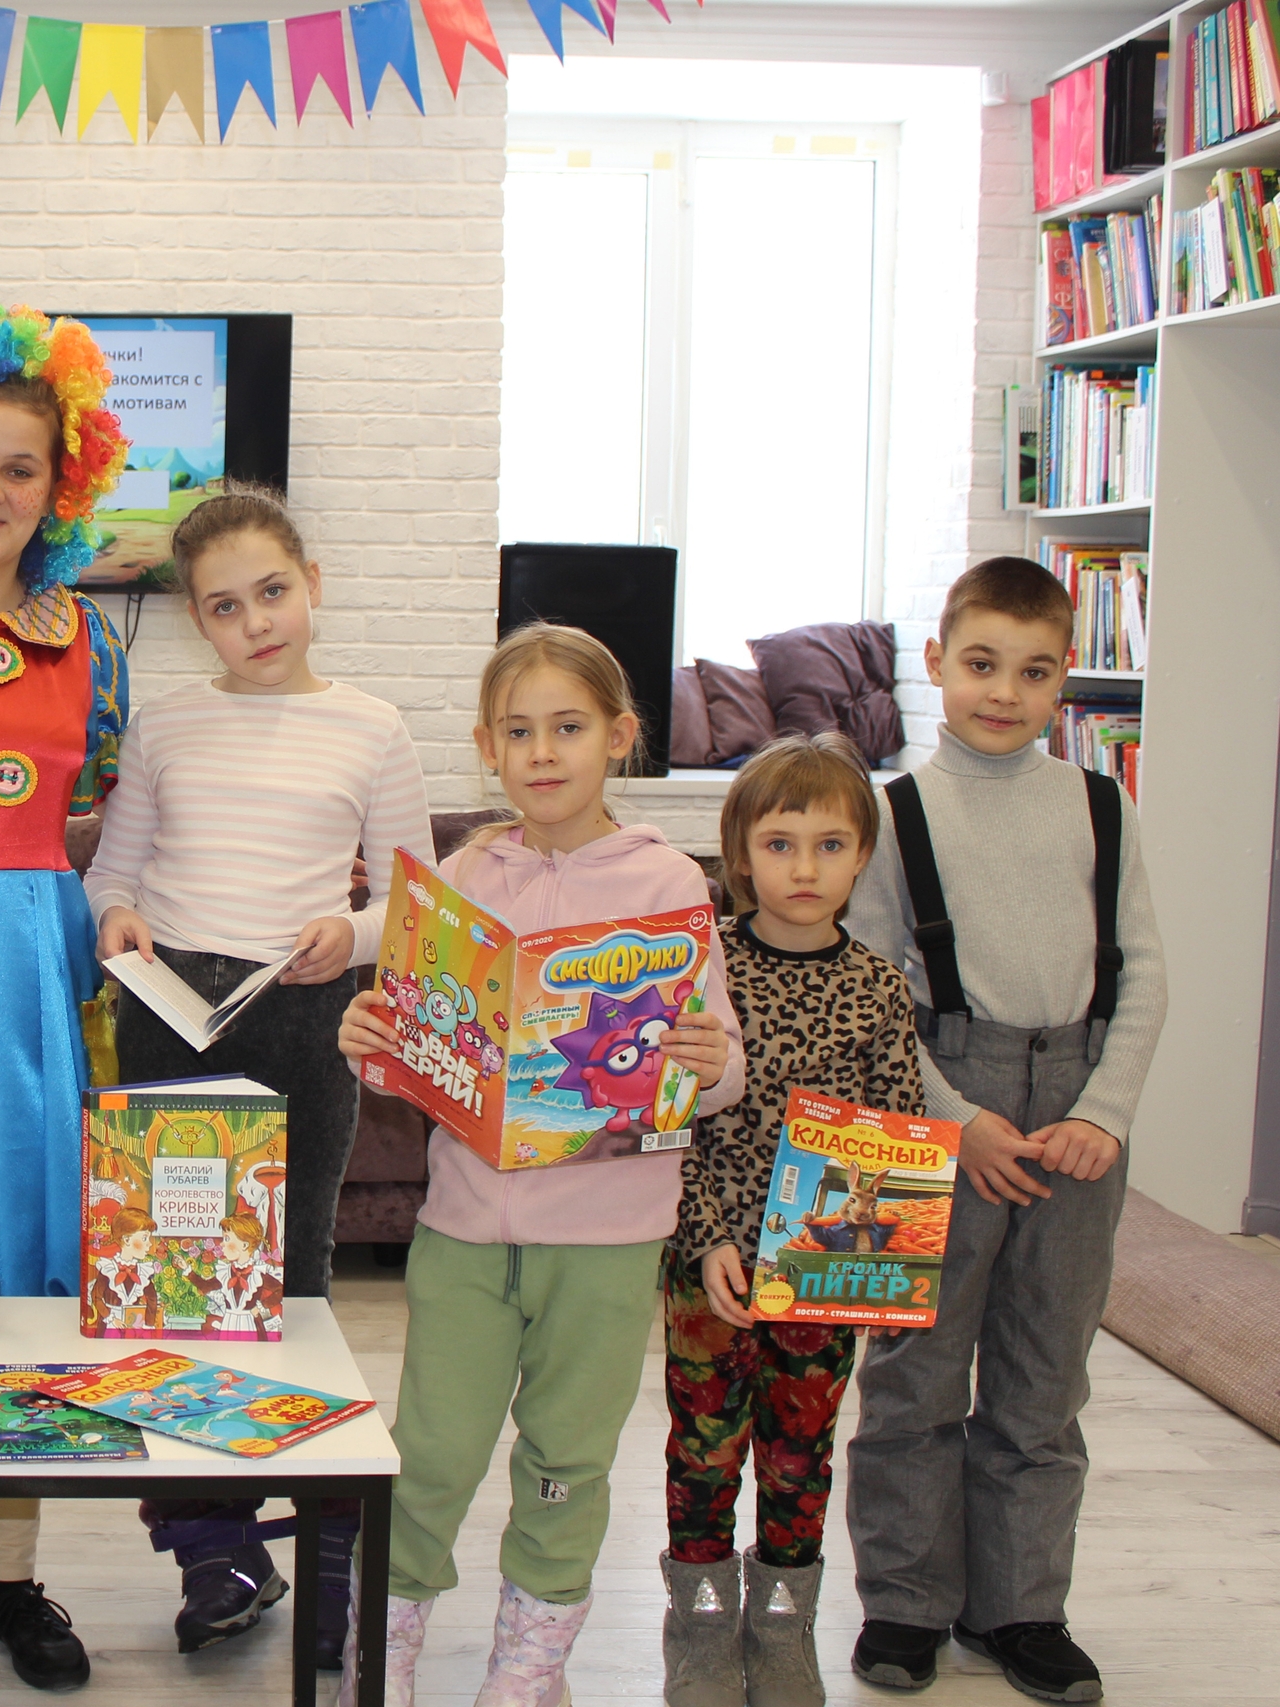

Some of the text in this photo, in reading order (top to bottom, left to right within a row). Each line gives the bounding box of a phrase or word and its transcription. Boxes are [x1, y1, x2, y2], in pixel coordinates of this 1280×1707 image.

[112, 398, 187, 409] мотивам
[522, 935, 553, 948] 09/2020
[550, 943, 688, 985] СМЕШАРИКИ
[521, 1012, 580, 1027] СМЕШЛАГЕРЬ!
[798, 1098, 841, 1115] КТО ОТКРЫЛ
[857, 1108, 882, 1120] ТАЙНЫ
[852, 1118, 884, 1130] КОСМОСА
[908, 1124, 931, 1133] ИЩЕМ
[910, 1131, 927, 1139] НЛО
[792, 1123, 938, 1167] КЛАССНЫЙ
[163, 1165, 213, 1175] ВИТАЛИЙ
[167, 1175, 209, 1185] ГУБАРЕВ
[154, 1190, 224, 1199] КОРОЛЕВСТВО
[159, 1201, 219, 1214] КРИВЫХ
[161, 1216, 216, 1229] ЗЕРКАЛ
[828, 1262, 907, 1277] КРОЛИК
[798, 1272, 931, 1305] ПИТЕР 2
[795, 1308, 927, 1321] ПОСТЕР СТРАШИЛКА КОМИКСЫ
[73, 1360, 190, 1403] КЛАССНЫЙ
